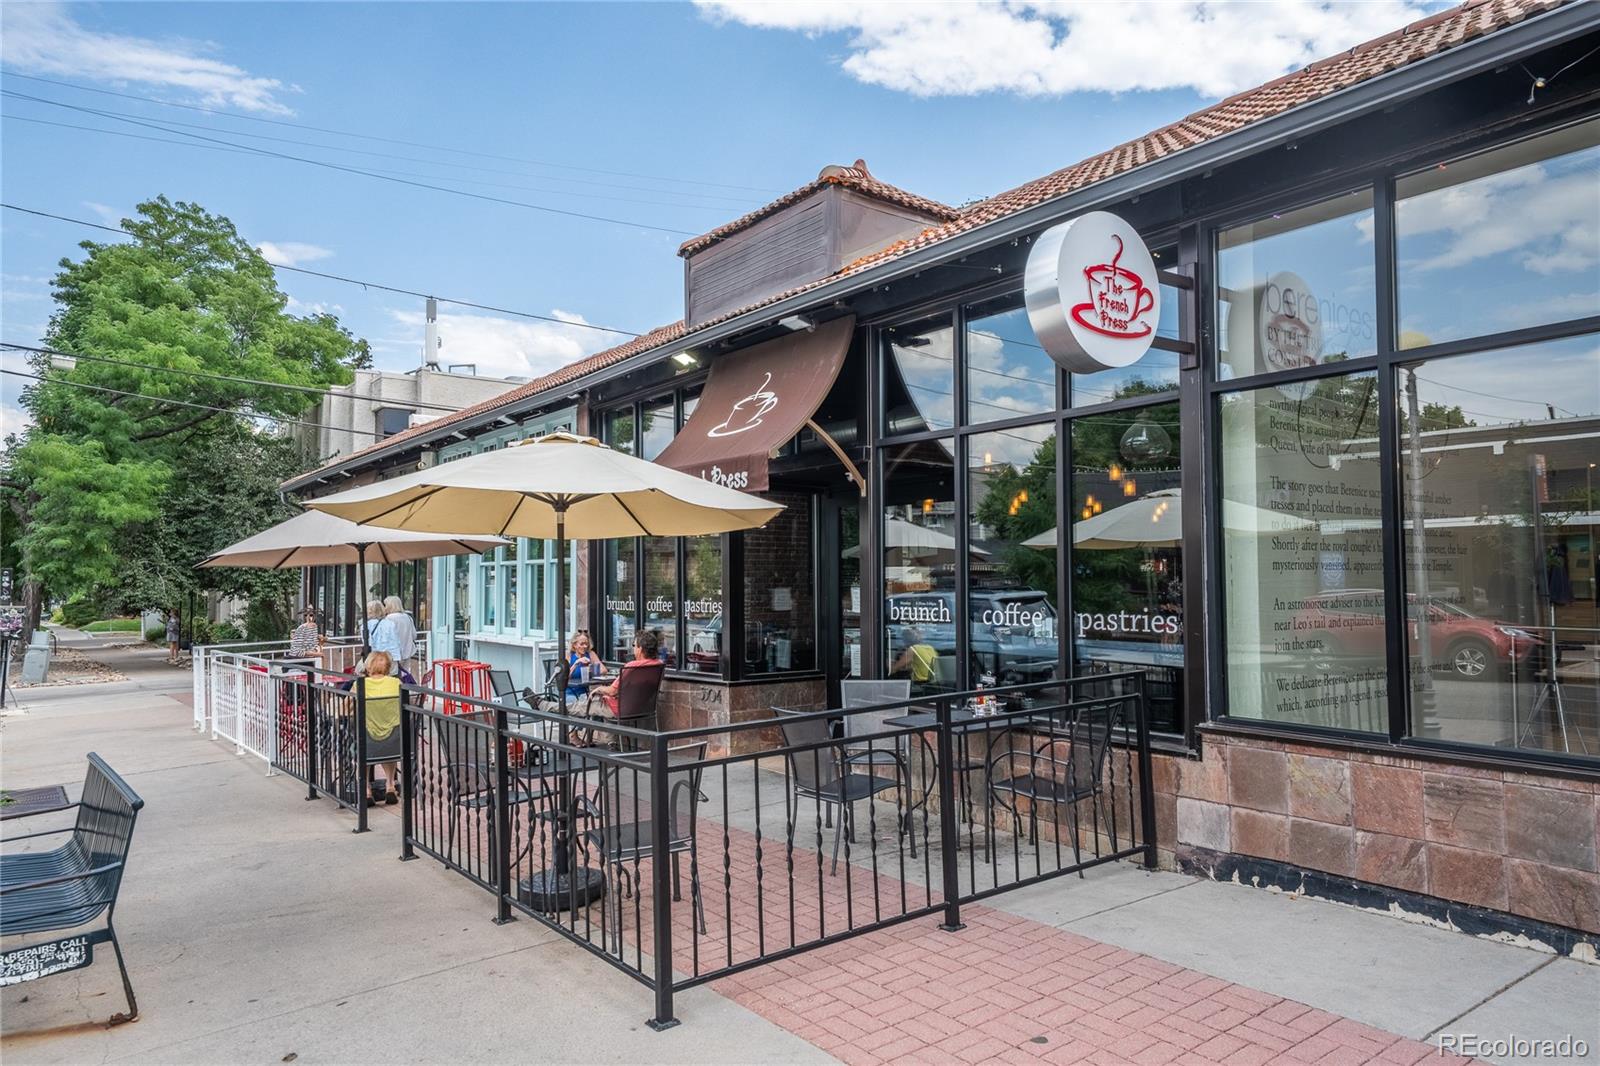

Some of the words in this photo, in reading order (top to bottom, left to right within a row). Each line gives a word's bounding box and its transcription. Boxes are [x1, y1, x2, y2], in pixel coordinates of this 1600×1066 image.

[1104, 276, 1123, 295] The
[1098, 292, 1129, 313] French
[1266, 272, 1373, 339] berenices
[1100, 311, 1129, 331] Press
[711, 465, 748, 488] Press
[1270, 475, 1286, 490] The
[1288, 482, 1306, 496] story
[1308, 483, 1324, 497] goes
[1325, 480, 1339, 495] that
[1340, 482, 1368, 498] Berenice
[1271, 500, 1294, 511] tresses
[1296, 499, 1310, 512] and
[1312, 500, 1334, 516] placed
[1336, 500, 1352, 514] them
[1354, 503, 1362, 514] in
[1362, 504, 1374, 516] the
[1272, 536, 1300, 554] Shortly
[1302, 537, 1318, 551] after
[1320, 538, 1330, 551] the
[1332, 540, 1348, 553] royal
[1272, 558, 1318, 574] mysteriously
[606, 595, 635, 611] brunch
[646, 596, 672, 612] coffee
[684, 598, 722, 620] pastries
[1274, 598, 1286, 611] An
[1288, 599, 1328, 610] astronomer
[1330, 596, 1353, 609] adviser
[1354, 598, 1362, 608] to
[1363, 595, 1374, 608] the
[888, 598, 951, 622] brunch
[982, 602, 1044, 628] coffee
[1078, 608, 1179, 638] pastries
[1274, 621, 1291, 632] near
[1293, 616, 1313, 630] Leo's
[1314, 616, 1326, 628] tail
[1328, 614, 1342, 628] and
[1342, 614, 1374, 631] explained
[1274, 638, 1290, 655] join
[1292, 636, 1304, 650] the
[1306, 640, 1325, 650] stars.
[1276, 678, 1290, 692] We
[1292, 676, 1322, 690] dedicate
[1356, 674, 1364, 682] to
[1364, 668, 1376, 681] the
[1276, 696, 1302, 712] which,
[1304, 692, 1338, 709] according
[1340, 694, 1348, 704] to
[60, 936, 88, 950] CALL
